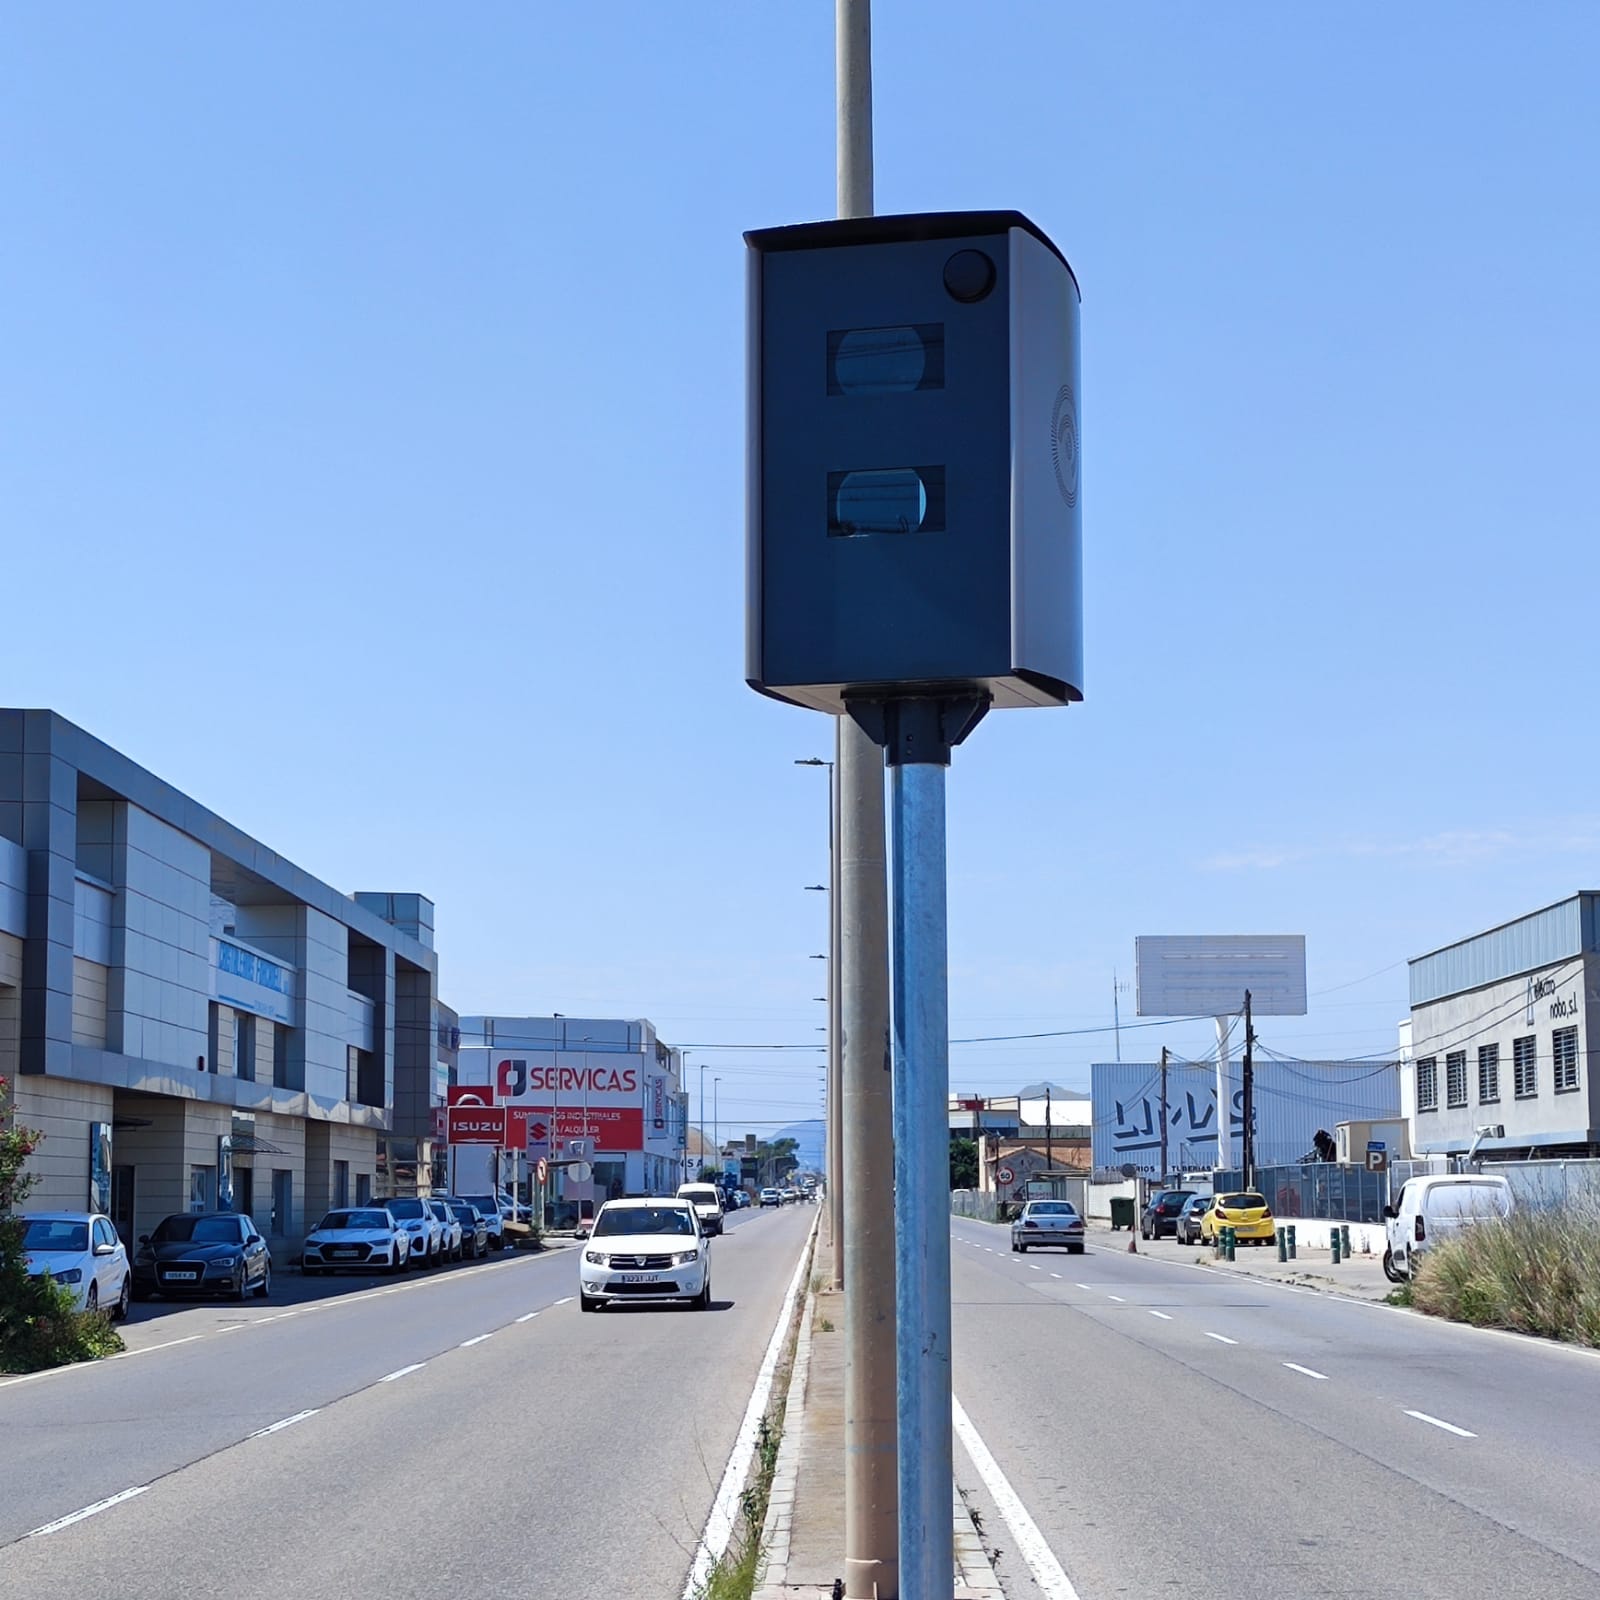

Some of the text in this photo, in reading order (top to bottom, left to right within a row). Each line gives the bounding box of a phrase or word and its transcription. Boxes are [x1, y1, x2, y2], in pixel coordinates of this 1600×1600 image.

[530, 1067, 637, 1092] SERVICAS
[453, 1122, 503, 1131] ISUZU
[565, 1126, 600, 1134] ALQULER
[1369, 1152, 1383, 1170] P
